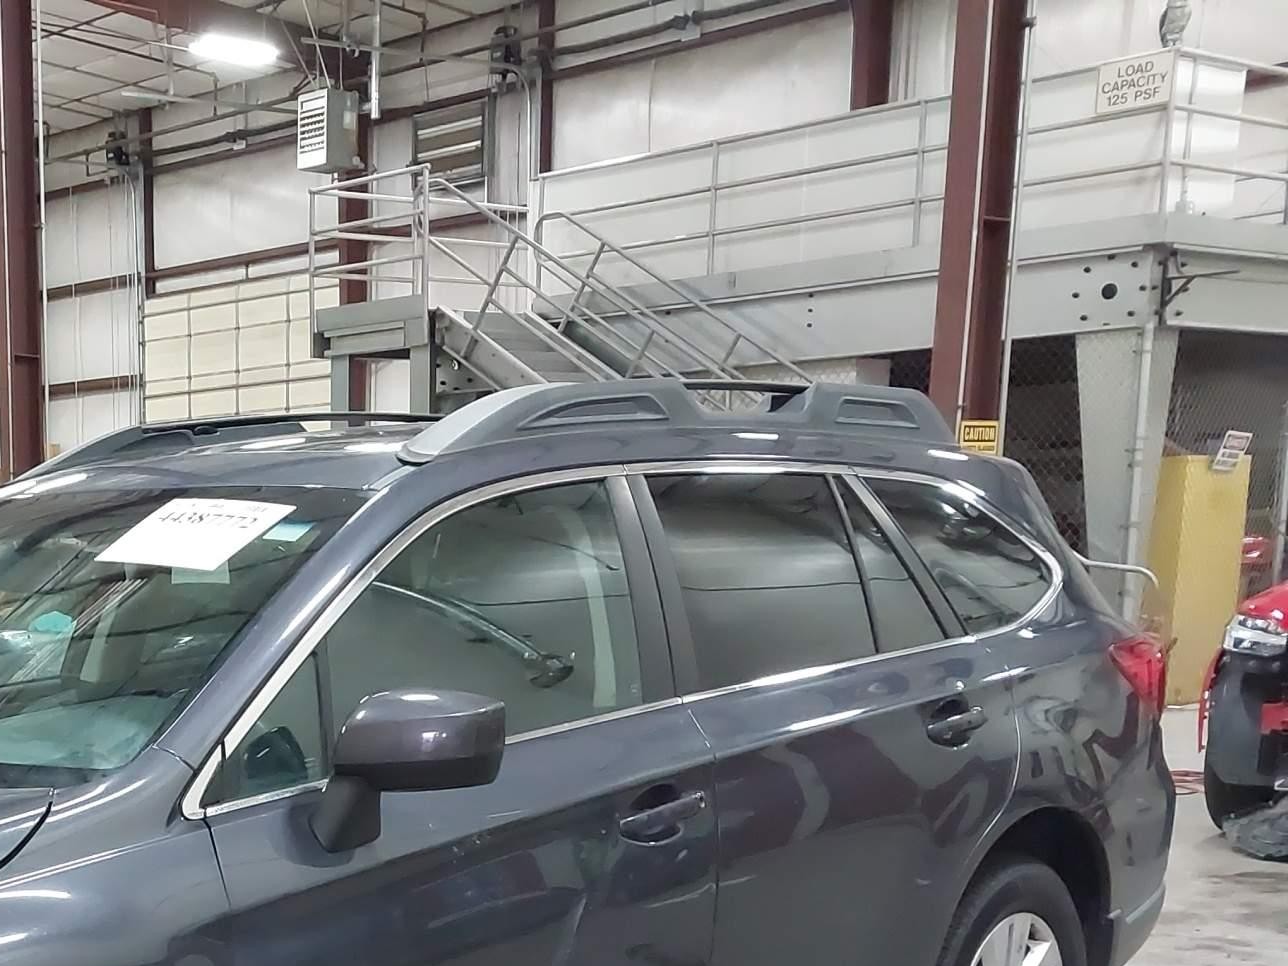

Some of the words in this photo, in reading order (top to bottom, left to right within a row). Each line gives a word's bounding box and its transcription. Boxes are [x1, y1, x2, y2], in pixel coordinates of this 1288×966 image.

[1117, 61, 1154, 78] LOAD
[1101, 70, 1169, 94] CAPACITY
[1106, 92, 1129, 107] 125
[1134, 86, 1161, 102] PSF
[964, 427, 996, 441] CAUTION
